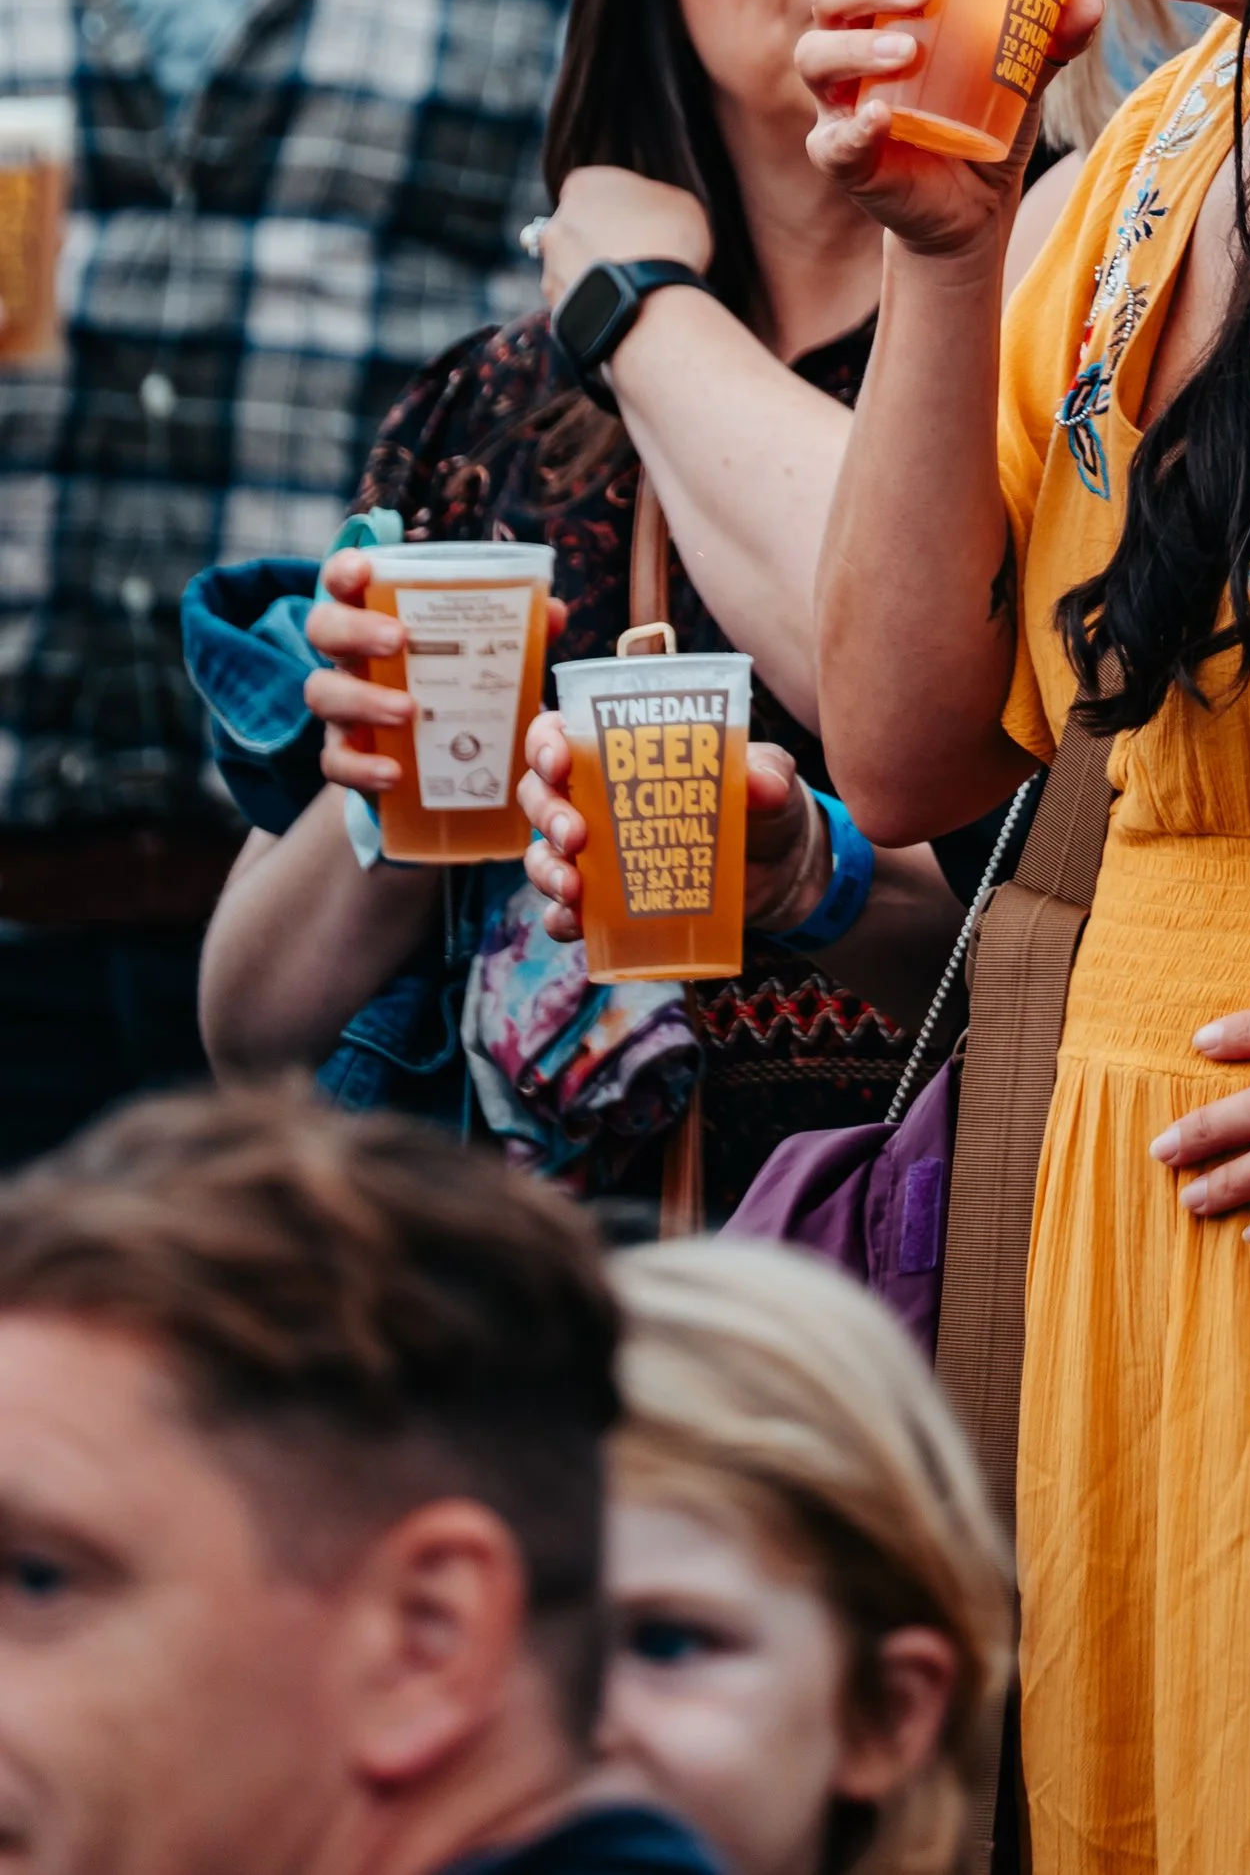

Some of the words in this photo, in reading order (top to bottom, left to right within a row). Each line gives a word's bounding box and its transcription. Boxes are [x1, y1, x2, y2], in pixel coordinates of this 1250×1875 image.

[1004, 35, 1018, 52] TO
[596, 695, 724, 727] TYNEDALE
[605, 723, 720, 782] BEER
[613, 782, 633, 819] &
[635, 779, 717, 817] CIDER
[618, 816, 715, 848] FESTIVAL
[622, 847, 688, 870] THUR
[690, 846, 712, 867] 12
[625, 872, 644, 887] TO
[647, 868, 688, 890] SAT
[691, 867, 711, 887] 14
[630, 889, 674, 912] JUNE
[673, 888, 710, 910] 2025
